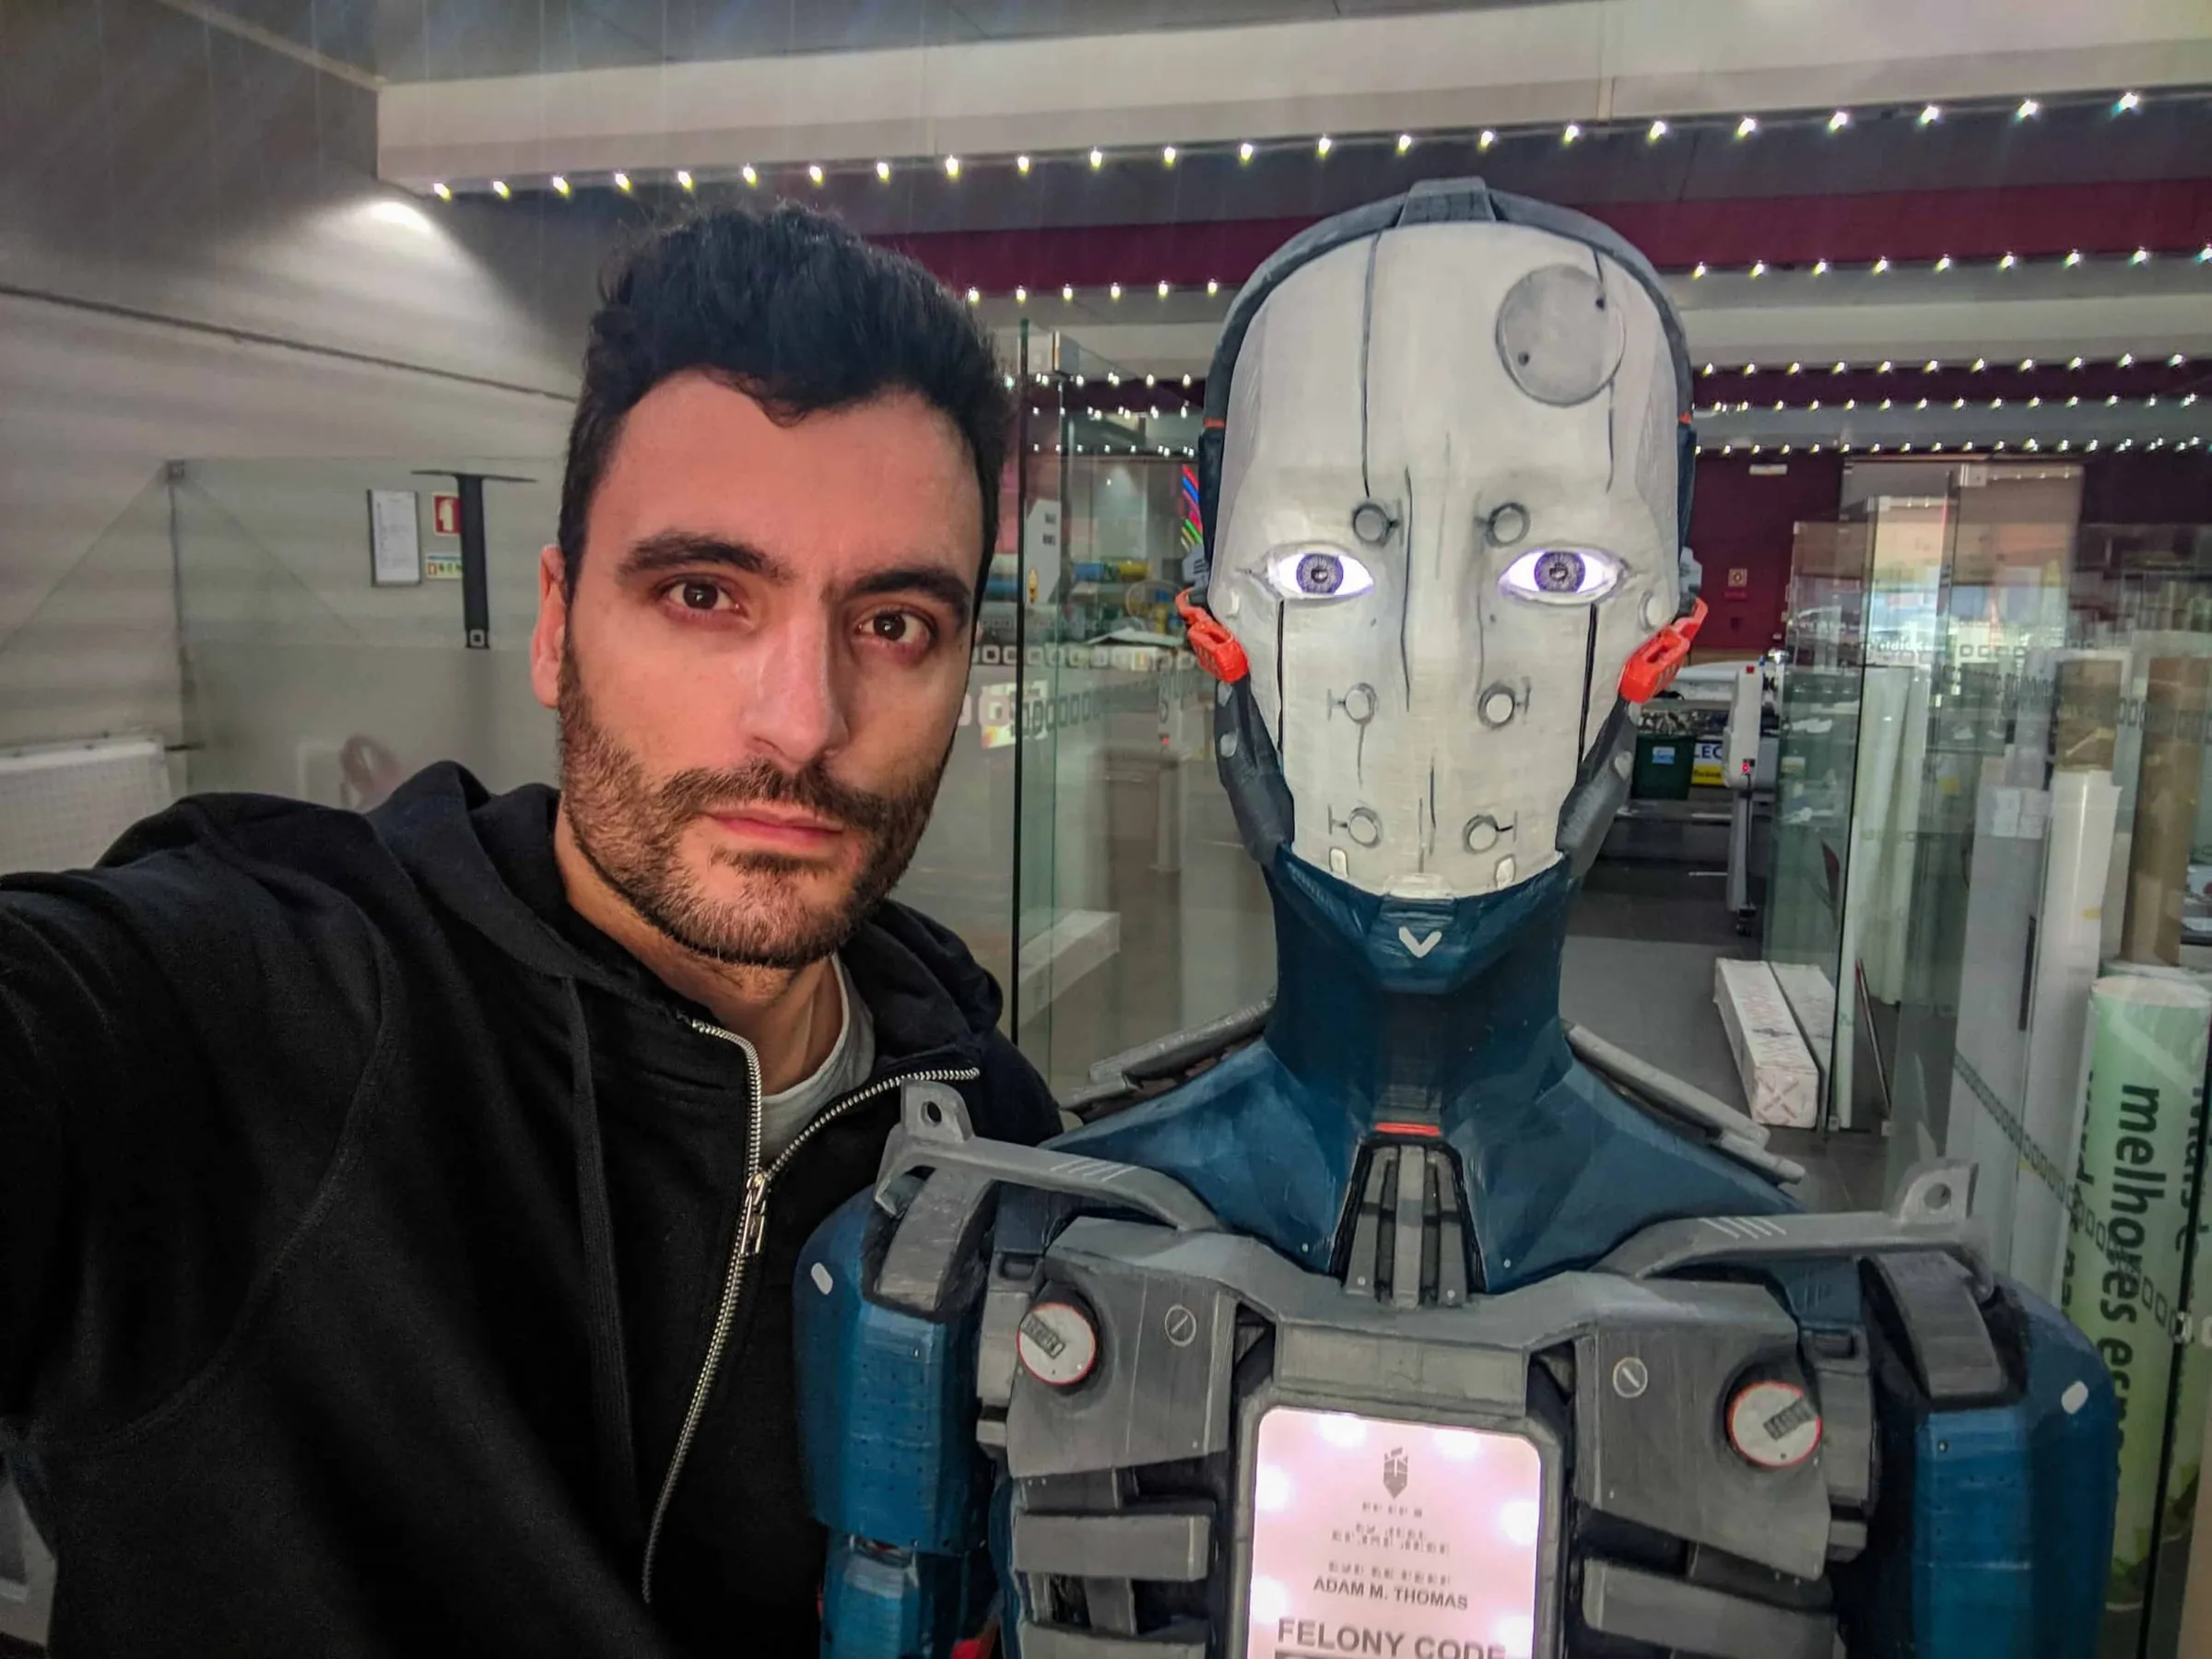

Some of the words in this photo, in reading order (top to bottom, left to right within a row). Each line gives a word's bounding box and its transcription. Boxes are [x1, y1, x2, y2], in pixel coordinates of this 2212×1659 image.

[2100, 1084, 2168, 1324] melhores
[1313, 1575, 1365, 1597] ADAM
[1369, 1585, 1389, 1601] M.
[1394, 1587, 1468, 1611] THOMAS
[1278, 1617, 1406, 1657] FELONY
